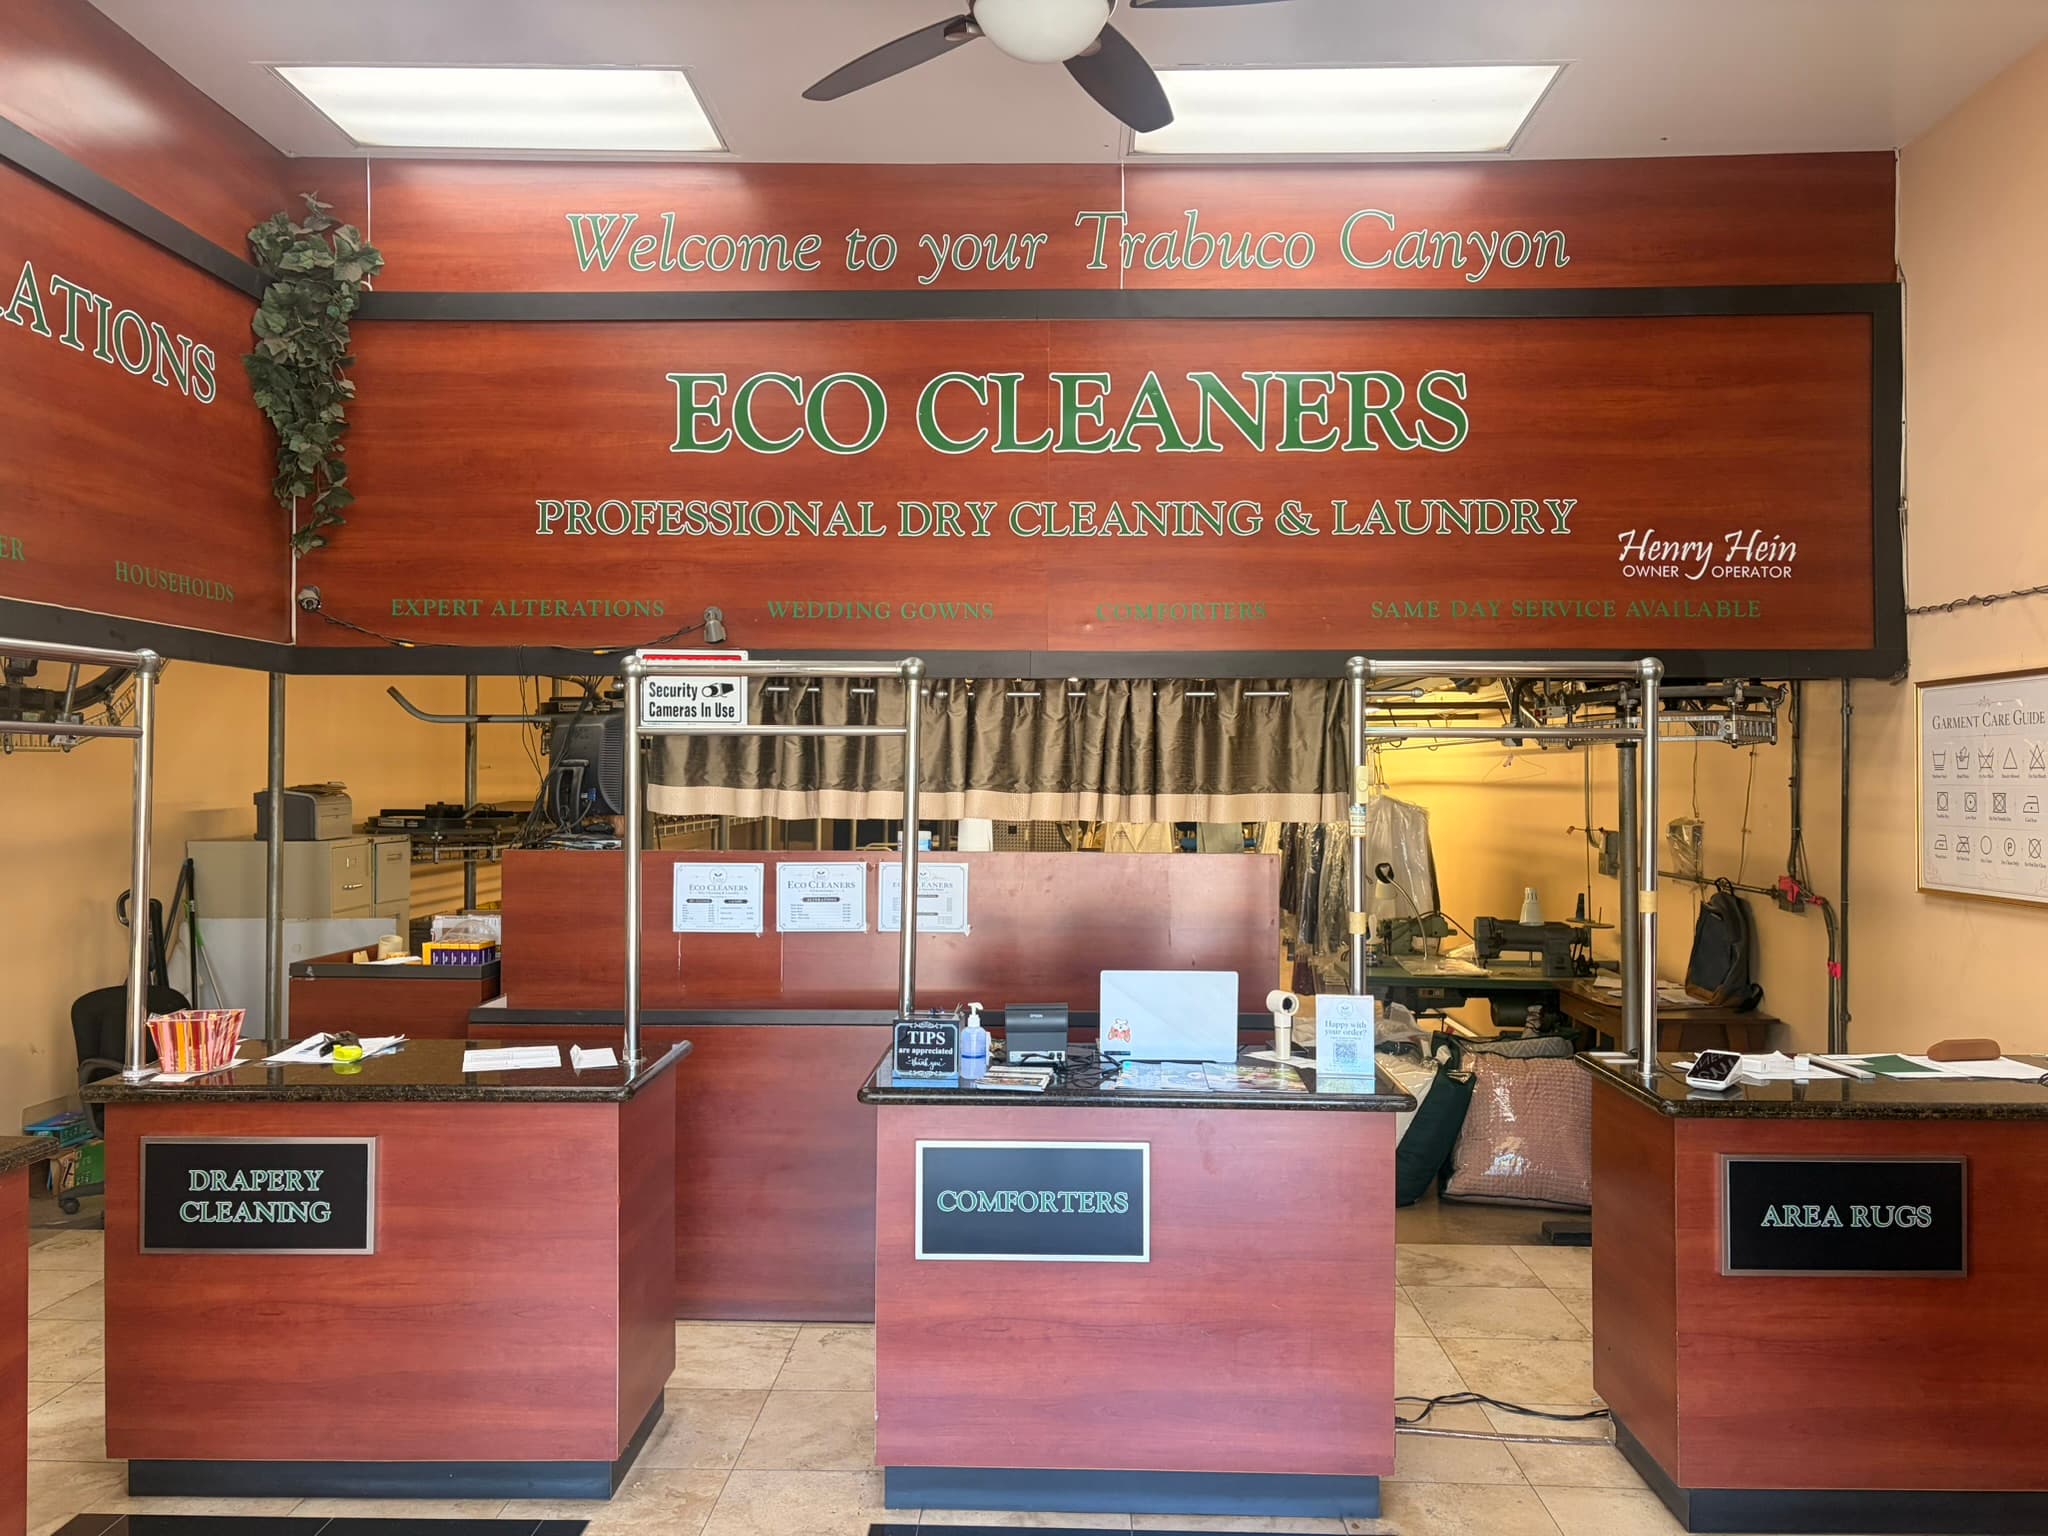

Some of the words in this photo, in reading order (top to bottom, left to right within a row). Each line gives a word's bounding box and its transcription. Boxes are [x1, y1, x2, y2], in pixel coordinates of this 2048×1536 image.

[565, 210, 822, 272] Welcome
[846, 226, 898, 272] to
[918, 230, 1048, 284] your
[1074, 209, 1316, 271] Trabuco
[1339, 208, 1571, 283] Canyon
[0, 260, 217, 403] ATIONS
[665, 371, 888, 455] ECO
[914, 369, 1470, 455] CLEANERS
[535, 498, 887, 537] PROFESSIONAL
[897, 499, 997, 537] DRY
[1008, 499, 1264, 537] CLEANING
[1275, 499, 1319, 537] &
[1331, 498, 1578, 536] LAUNDRY
[1618, 528, 1713, 580] Henry
[1725, 529, 1797, 562] Hein
[115, 560, 235, 602] HOUSEHOLDS
[1622, 565, 1679, 577] OWNER
[1711, 565, 1792, 578] OPERATOR
[391, 599, 484, 617] EXPERT
[490, 599, 665, 617] ALTERATIONS
[767, 599, 892, 620] WEDDING
[900, 600, 994, 620] GOWNS
[1096, 601, 1267, 621] COMFORTERS
[1371, 600, 1440, 618] SAME
[1452, 600, 1503, 618] DAY
[1511, 600, 1616, 618] SERVICE
[1626, 600, 1761, 618] AVAILABLE
[648, 681, 698, 701] Security
[649, 702, 697, 717] Cameras
[701, 702, 711, 717] In
[715, 702, 735, 717] Use
[1932, 713, 1980, 730] GARMENT
[1982, 710, 2011, 728] CARE
[2013, 708, 2046, 726] GUIDE
[788, 880, 807, 889] ECO
[808, 880, 856, 889] CLEANERS
[1325, 1020, 1349, 1030] Happy
[1351, 1020, 1367, 1028] with
[1325, 1029, 1342, 1037] your
[907, 1031, 946, 1045] TIPS
[912, 1047, 953, 1056] appreciated
[189, 1169, 324, 1192] DRAPERY
[179, 1201, 332, 1223] CLEANING
[937, 1190, 1129, 1213] COMFORTERS
[1760, 1204, 1843, 1227] AREA
[1850, 1205, 1932, 1227] RUGS
